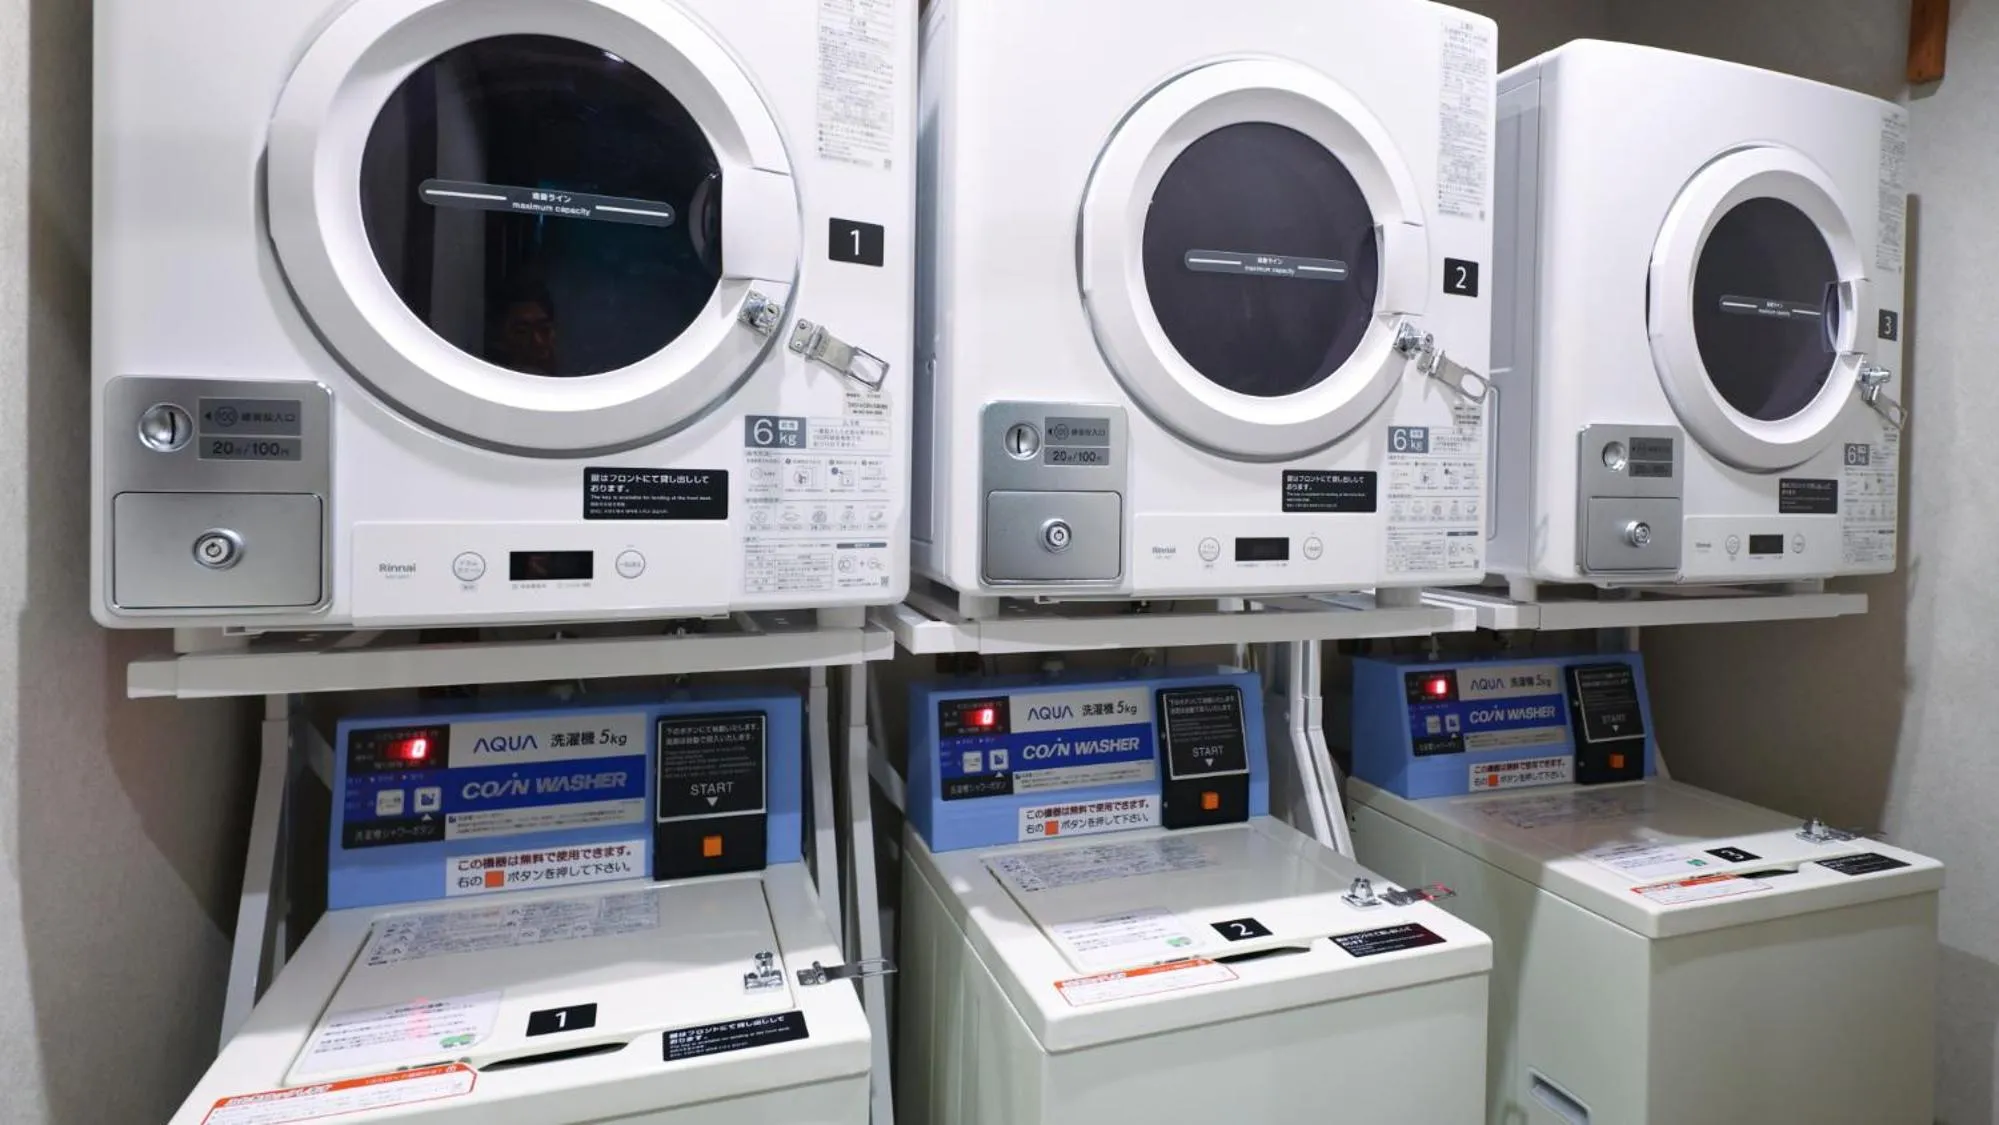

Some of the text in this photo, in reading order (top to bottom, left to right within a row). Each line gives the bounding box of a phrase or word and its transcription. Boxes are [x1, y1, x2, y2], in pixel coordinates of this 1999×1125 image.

[512, 202, 592, 217] maximum capacity
[850, 229, 860, 256] 1
[1455, 266, 1467, 289] 2
[1884, 316, 1894, 335] 3
[753, 418, 774, 445] 6
[779, 431, 797, 446] kg
[1393, 428, 1407, 451] 6
[379, 562, 416, 573] Rinnai
[1470, 677, 1505, 691] AQUA
[1027, 704, 1075, 721] AQUA
[1116, 700, 1138, 715] 5kg
[1507, 705, 1556, 720] WASHER
[982, 708, 994, 725] 0
[473, 735, 538, 754] AQUA
[550, 728, 628, 748] 洗濯機 5kg
[1074, 737, 1141, 756] WASHER
[412, 739, 426, 759] 0
[1192, 745, 1225, 758] START
[535, 771, 628, 795] WASHER
[689, 781, 735, 796] START
[457, 874, 483, 889] 右の
[1230, 923, 1254, 937] 2
[554, 1012, 567, 1029] 1
